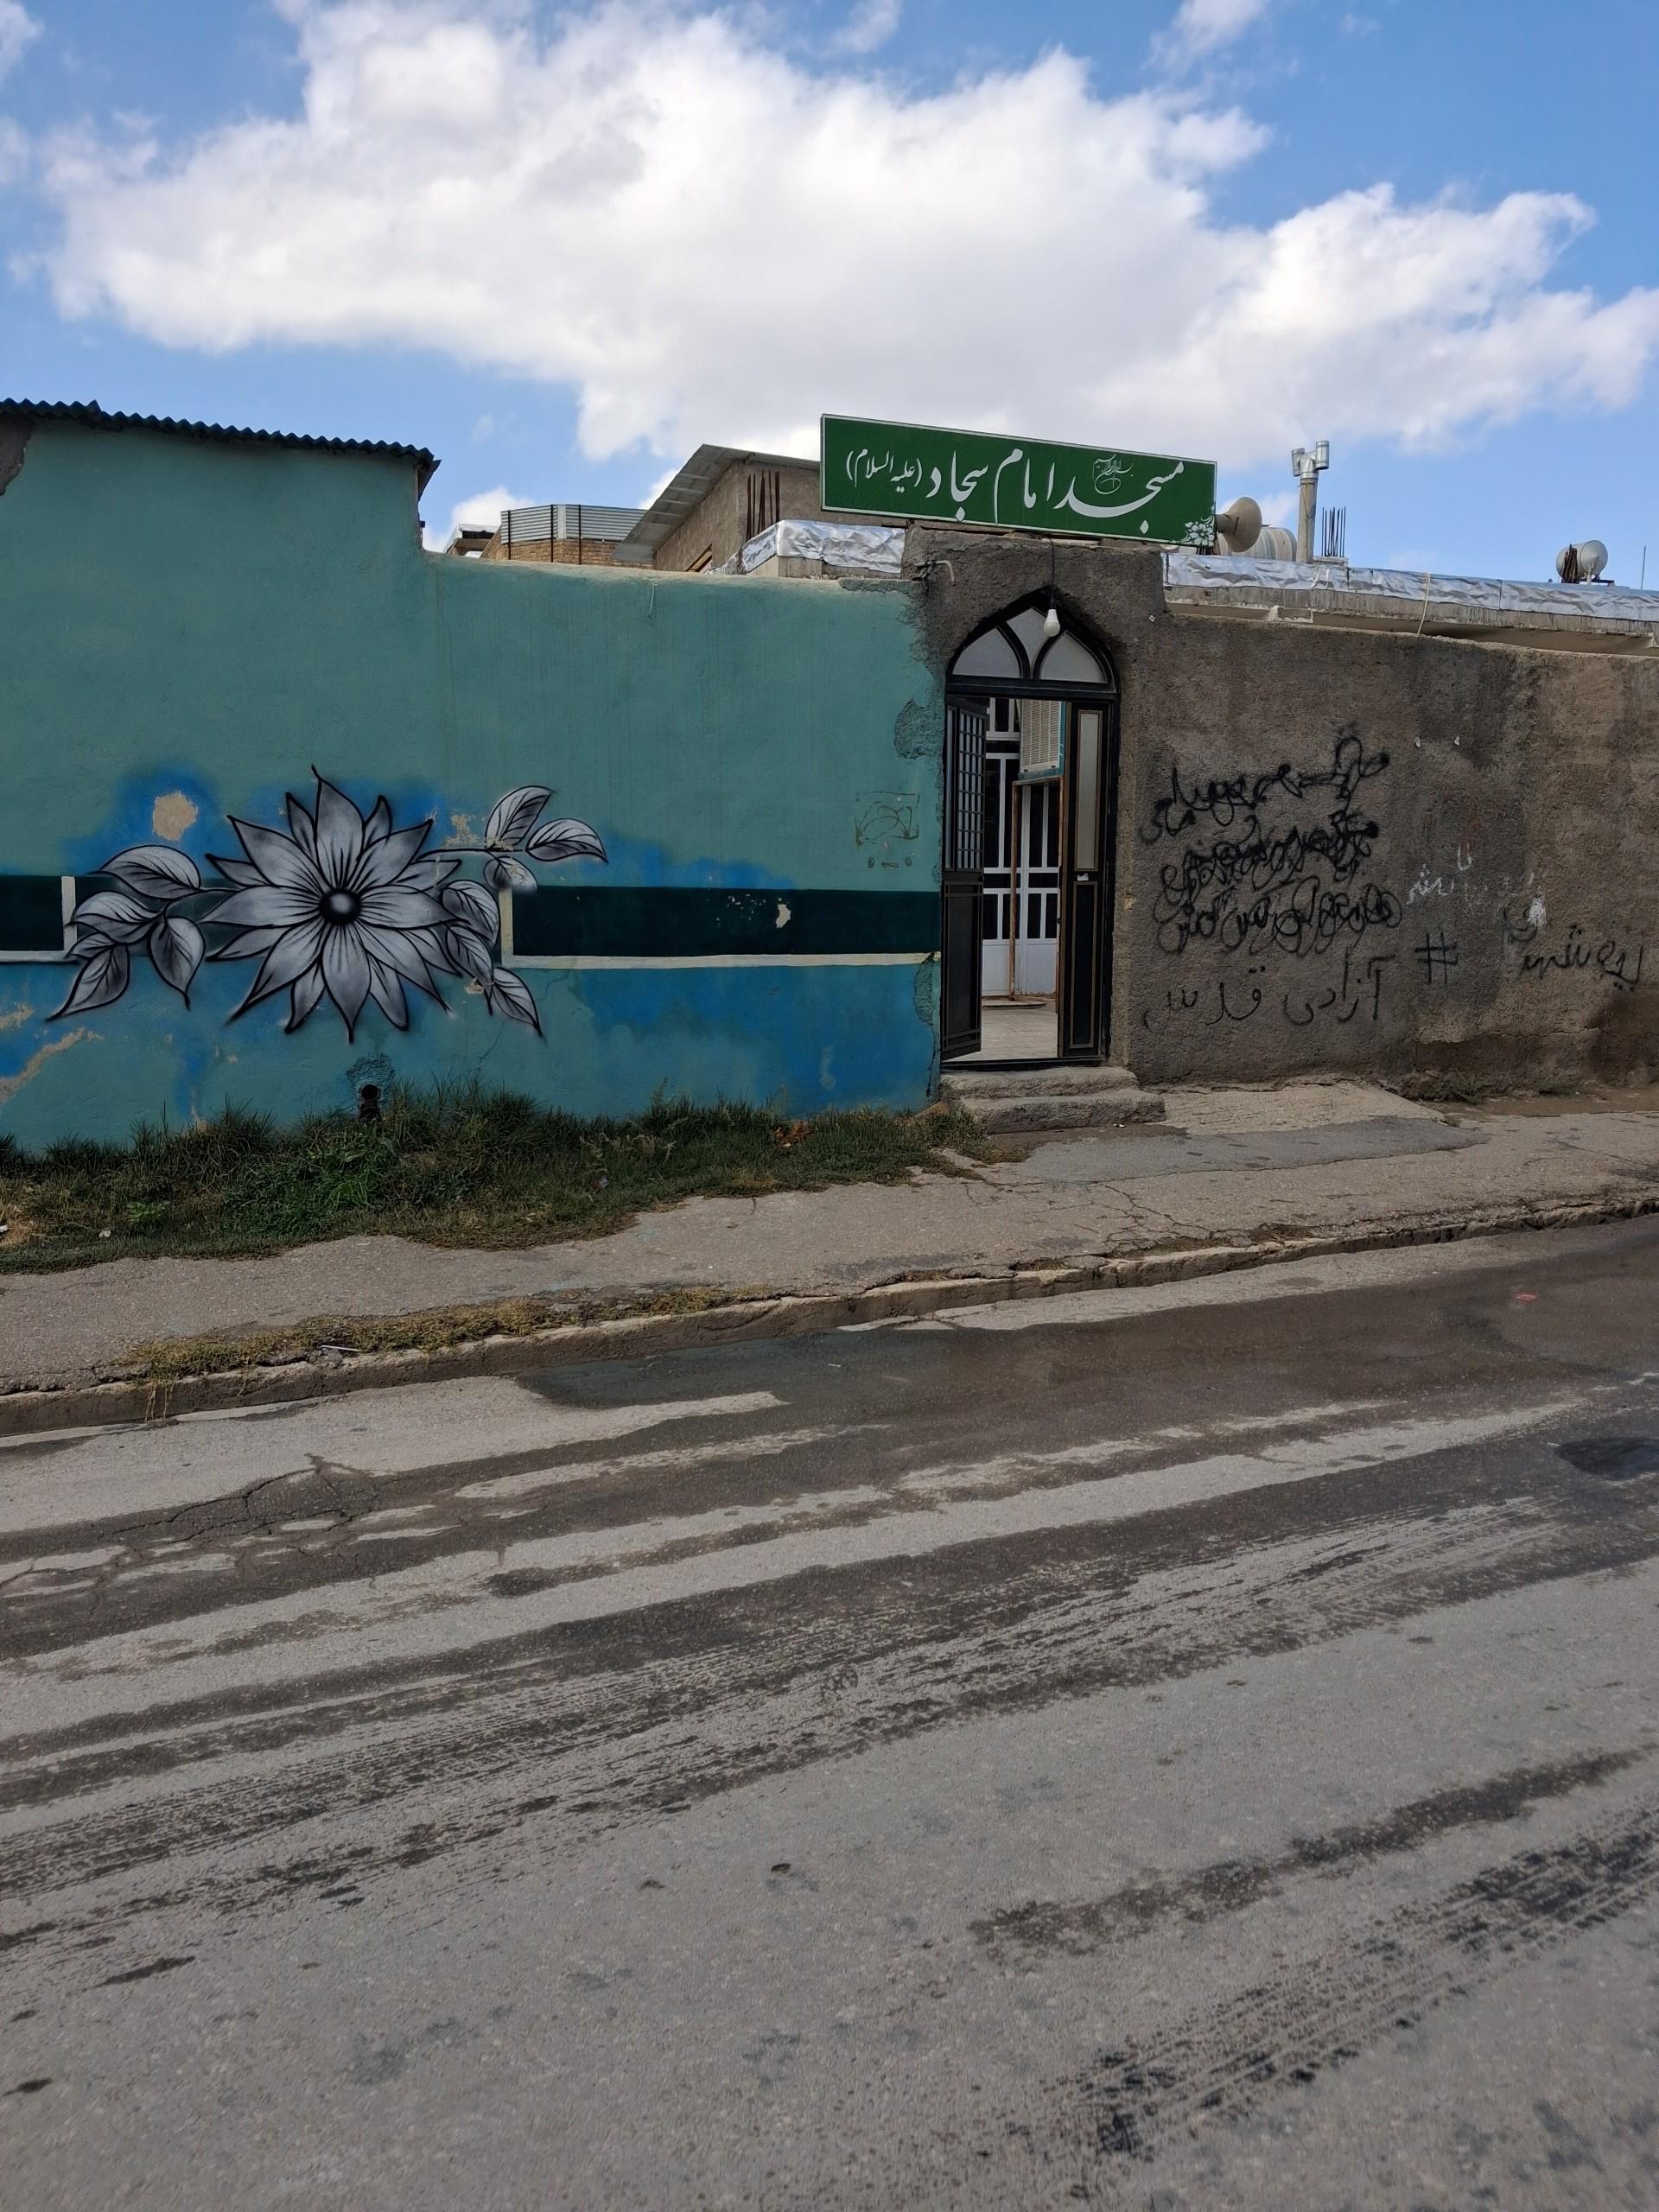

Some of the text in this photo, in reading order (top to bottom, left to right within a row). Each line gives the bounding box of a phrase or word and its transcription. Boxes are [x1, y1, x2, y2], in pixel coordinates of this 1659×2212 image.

[845, 448, 895, 488] السلام)
[925, 449, 989, 522] سجاد
[994, 448, 1055, 524] امام
[1052, 461, 1185, 534] مسجد
[1283, 949, 1395, 1026] آزادی
